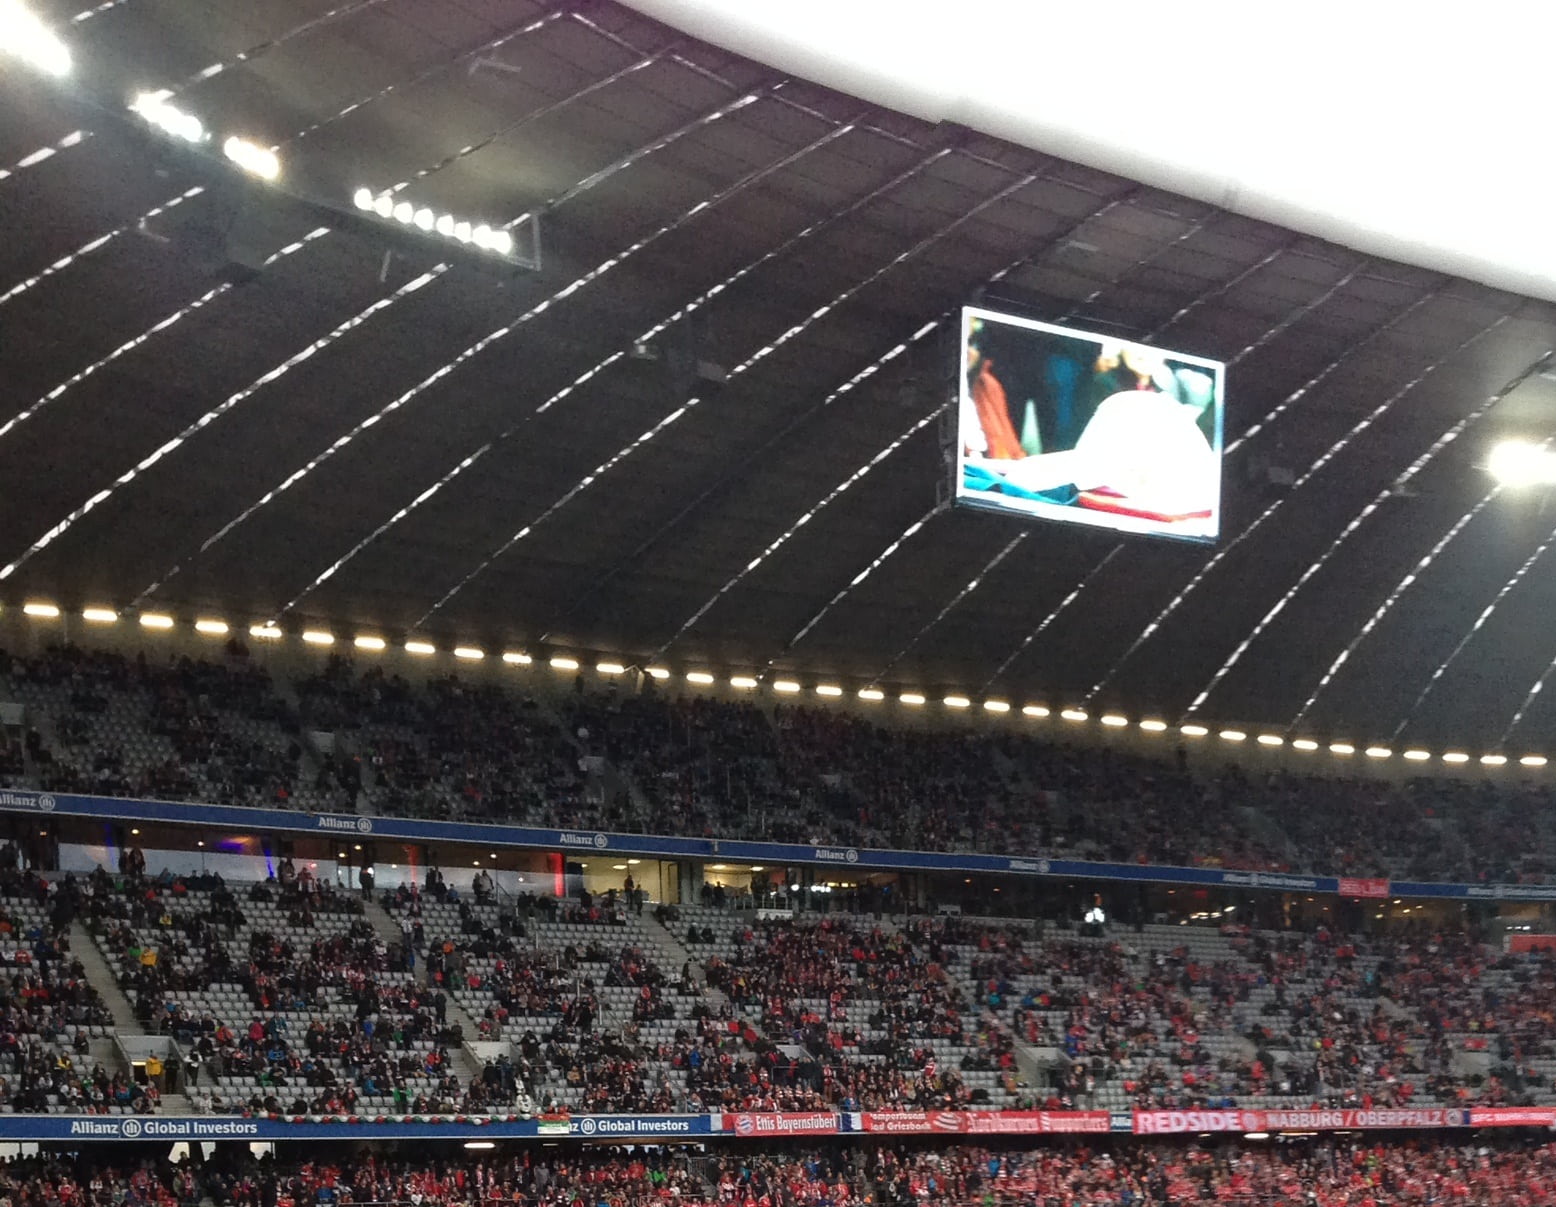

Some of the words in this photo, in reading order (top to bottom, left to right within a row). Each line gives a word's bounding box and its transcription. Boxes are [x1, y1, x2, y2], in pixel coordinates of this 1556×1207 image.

[318, 816, 356, 829] Allianz
[560, 834, 593, 846] Allianz
[815, 849, 845, 860] Allianz
[73, 1121, 120, 1134] Allianz
[146, 1121, 193, 1134] Global
[194, 1121, 260, 1134] Investors
[599, 1120, 636, 1132] Global
[637, 1120, 690, 1132] Investors
[1137, 1112, 1240, 1131] REDSIDE
